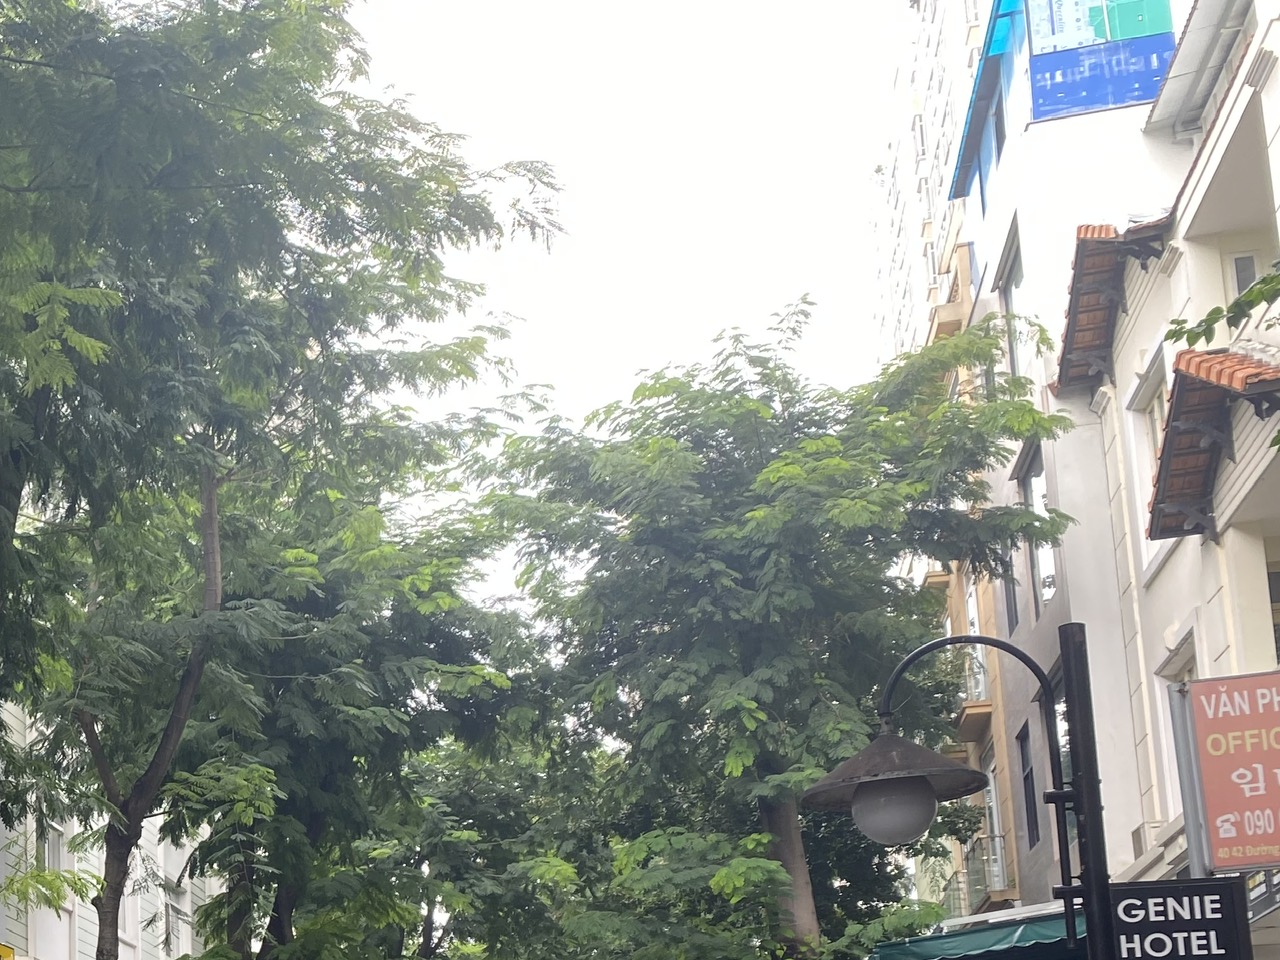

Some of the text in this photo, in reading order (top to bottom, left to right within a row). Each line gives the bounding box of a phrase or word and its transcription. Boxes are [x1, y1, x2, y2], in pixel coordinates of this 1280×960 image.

[1201, 686, 1250, 719] VĂN
[1231, 763, 1280, 797] 임
[1117, 895, 1222, 923] GENIE
[1119, 930, 1226, 958] HOTEL
